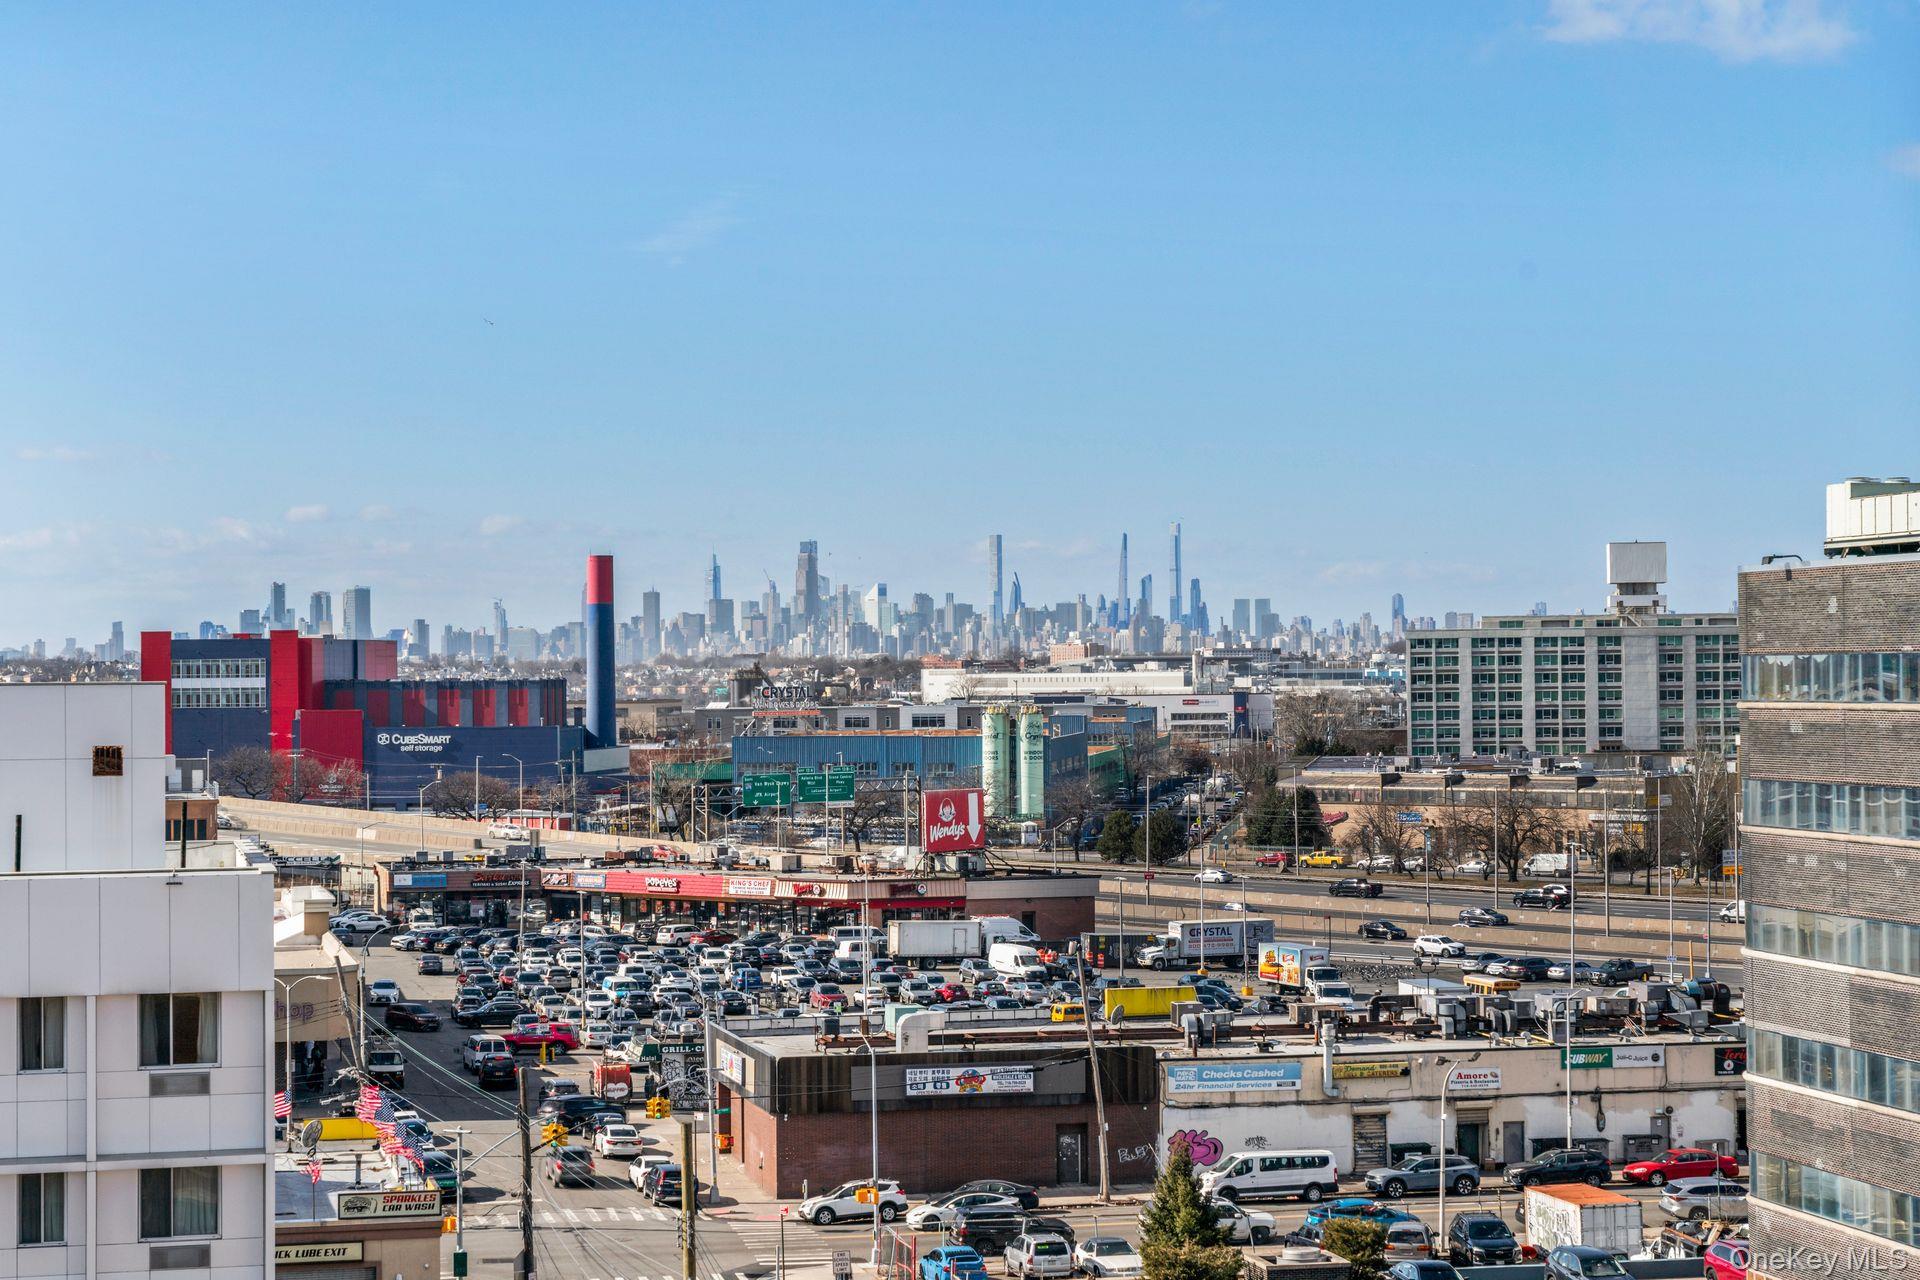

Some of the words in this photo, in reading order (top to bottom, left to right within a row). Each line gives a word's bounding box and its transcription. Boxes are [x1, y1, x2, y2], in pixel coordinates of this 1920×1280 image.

[762, 686, 813, 698] CRYSTAL
[930, 818, 966, 843] Wendy's
[1189, 926, 1232, 937] CRYSTAL
[1564, 1053, 1608, 1065] SUBWAY
[1203, 1069, 1245, 1079] Checks
[1246, 1068, 1284, 1078] Cashed
[1457, 1072, 1489, 1080] Amore
[382, 1193, 437, 1204] SPARKLES
[382, 1204, 402, 1212] CAR
[405, 1202, 435, 1211] WASH
[295, 1248, 322, 1258] LUBE
[324, 1247, 348, 1256] EXIT
